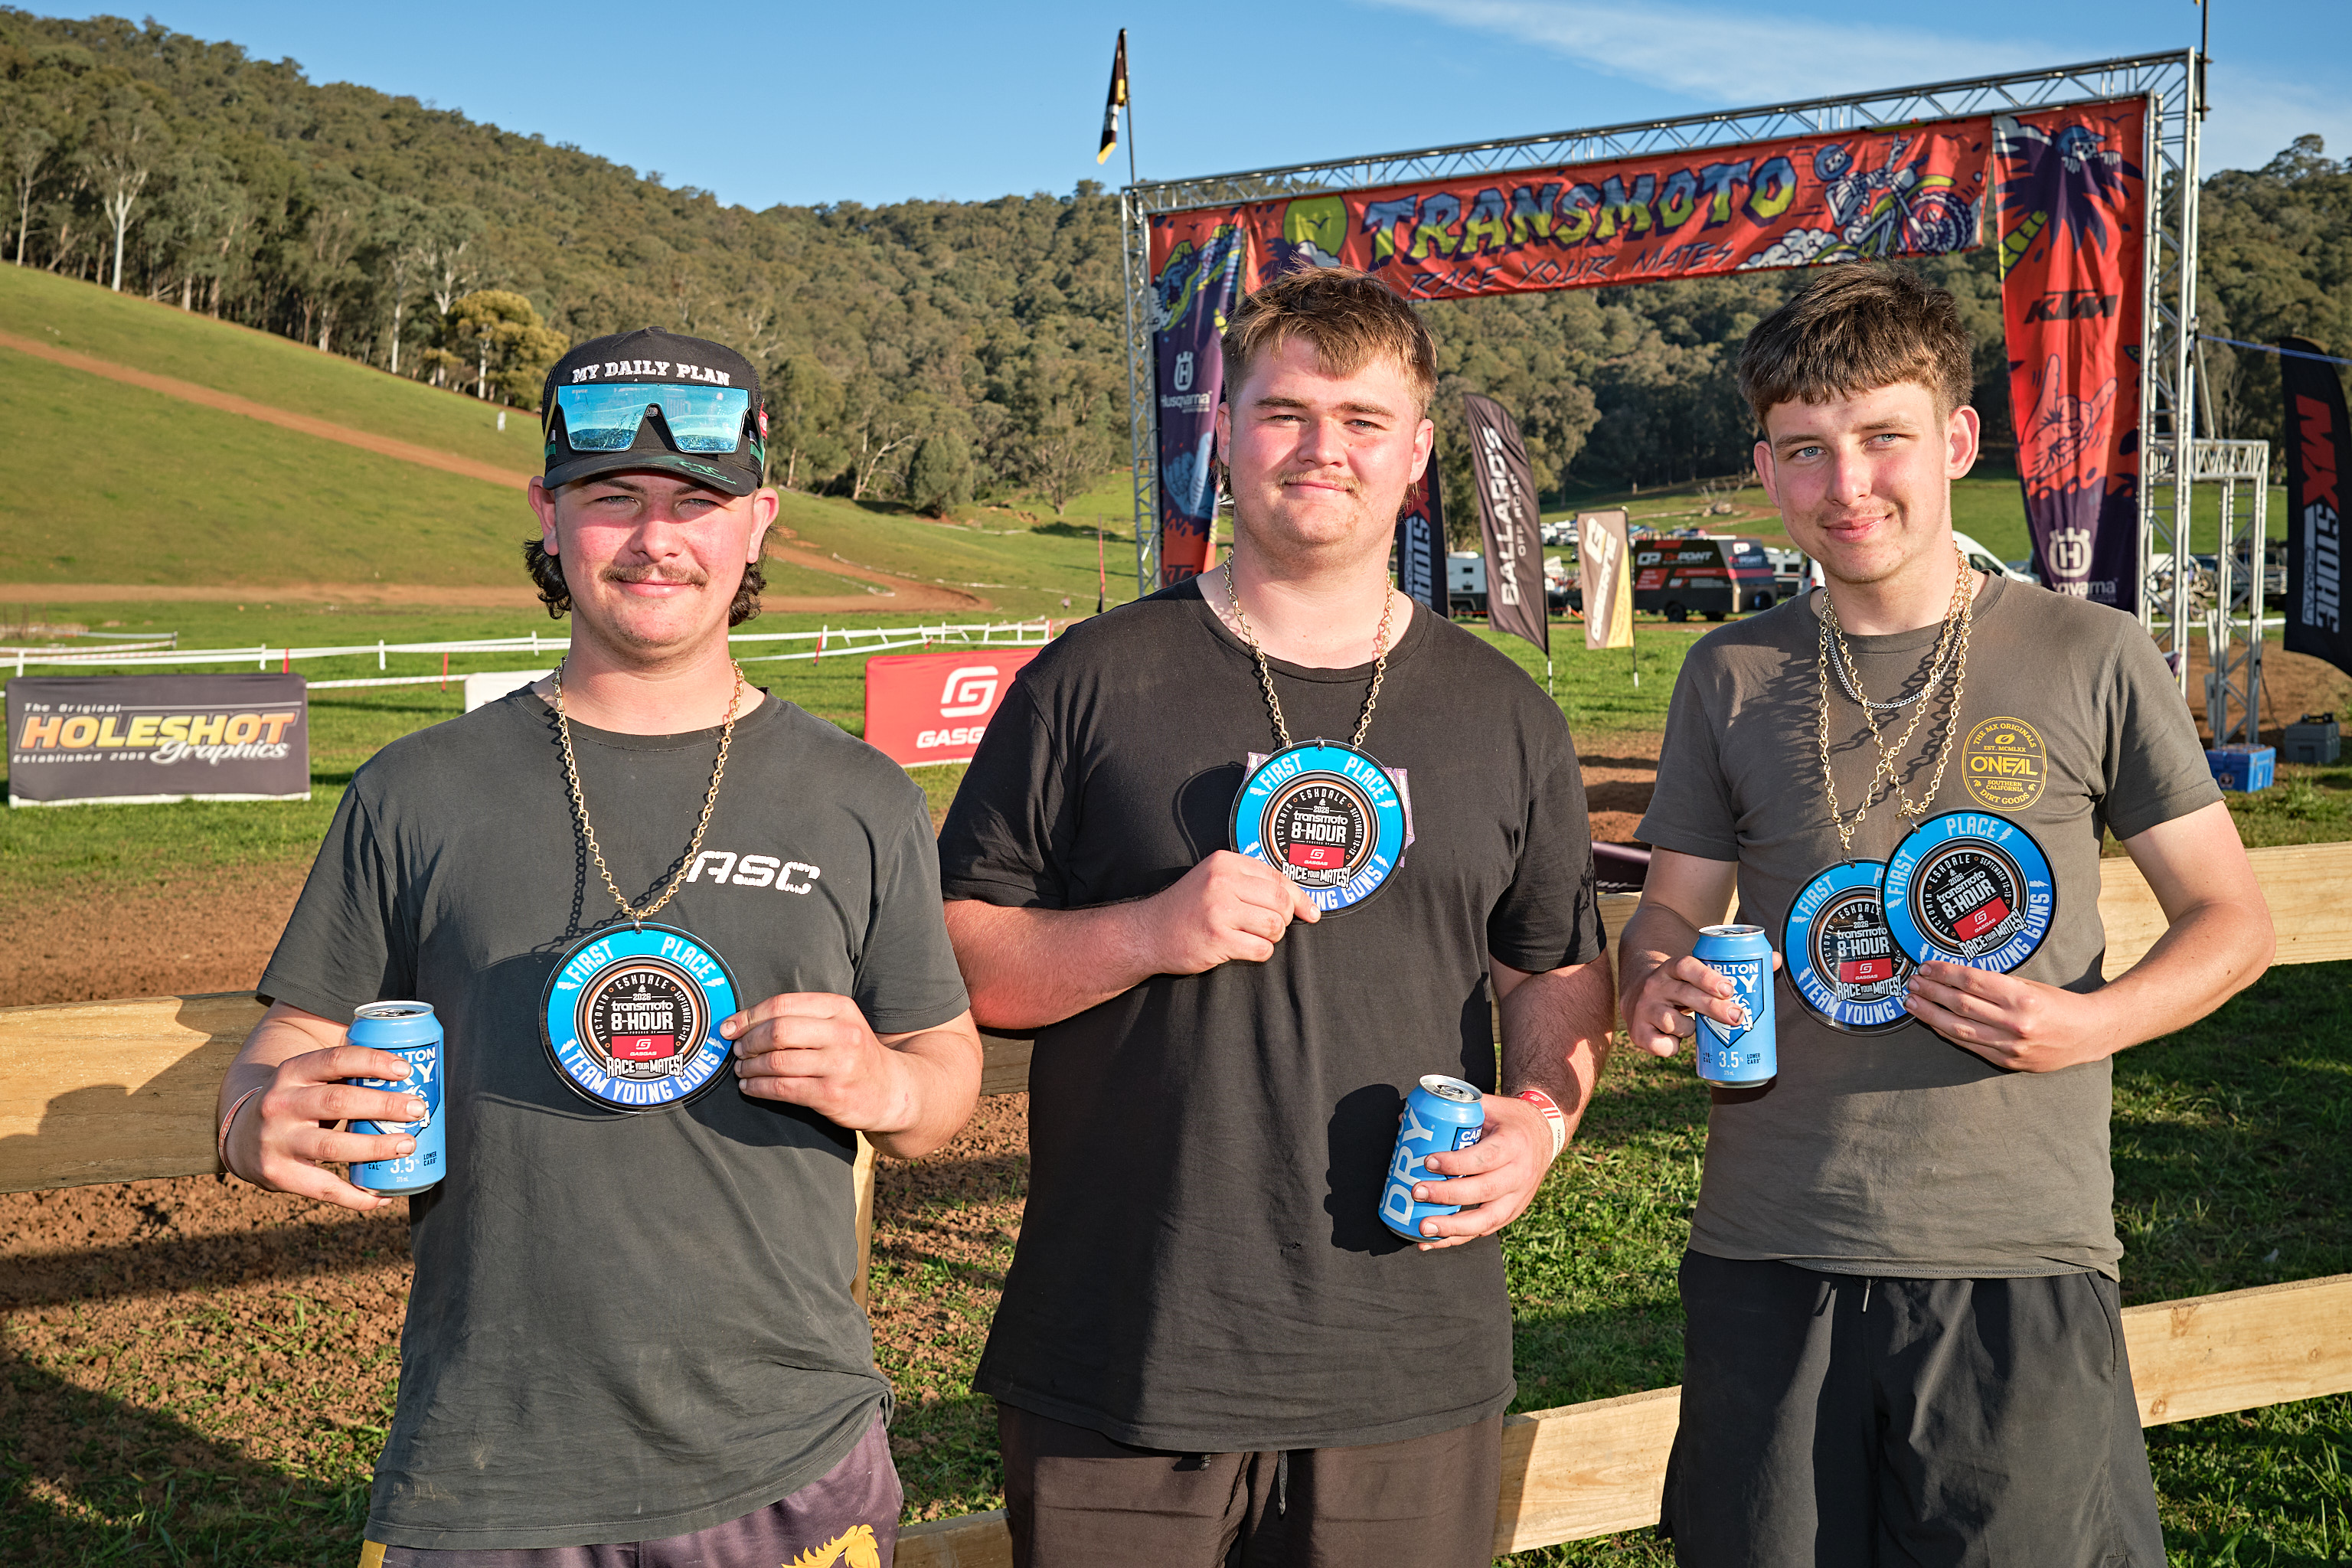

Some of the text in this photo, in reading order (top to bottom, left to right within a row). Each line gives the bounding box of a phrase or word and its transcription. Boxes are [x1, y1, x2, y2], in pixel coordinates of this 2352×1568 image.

[1363, 156, 1798, 264] TRANSMOTO
[1407, 240, 1735, 299] RACE YOUR MATES
[2024, 289, 2118, 324] KTM
[572, 359, 730, 387] MY DAILY PLAN
[2295, 394, 2340, 514] MX
[1482, 425, 1521, 606] BALLARD'S
[24, 702, 122, 715] The Original
[19, 712, 297, 750] HOLESHOT
[916, 726, 987, 749] GASG
[1973, 723, 2037, 749] THE MX ORIGINALS
[12, 752, 103, 765] Established
[1258, 753, 1392, 801] FIRST PLACE
[1986, 784, 2024, 792] CALIFORNIA
[1299, 788, 1348, 805] ESKDALE
[1313, 805, 1330, 814] 2026
[1979, 789, 2030, 805] DIRT GOODS
[1276, 802, 1293, 848] VICTORIA
[1291, 821, 1347, 844] 8-HOUR
[1293, 809, 1349, 825] transmoto
[1886, 848, 1916, 896] FIRST
[1945, 815, 2000, 838] PLACE
[1929, 854, 1971, 884] ESKDALE
[685, 850, 822, 895] ASC
[1282, 861, 1308, 882] RACE
[1319, 866, 1351, 889] MATES!
[1341, 864, 1383, 903] GUNS
[1936, 871, 1986, 903] transmoto
[1948, 872, 1965, 886] 2026
[1980, 857, 2012, 897] SEPTEMBER 12-13
[1798, 875, 1836, 916] FIRST
[1941, 878, 1998, 920] 8-HOUR
[1854, 920, 1869, 929] 2026
[1925, 893, 1949, 934] VICTORIA
[1975, 918, 1997, 933] GASGAS
[1823, 924, 1836, 968] VICTORIA
[1836, 926, 1888, 940] transmoto
[1837, 936, 1891, 958] 8-HOUR
[1957, 907, 2028, 962] RACE YOUR MATES!
[1978, 936, 2031, 973] YOUNG
[2023, 893, 2050, 940] GUNS
[565, 936, 717, 984] FIRST PLACE
[1802, 976, 1841, 1016] TEAM
[1844, 1000, 1897, 1024] YOUNG
[1836, 975, 1903, 1002] RACE YOUR MATES!
[594, 994, 609, 1041] VICTORIA
[611, 1000, 674, 1011] transmoto
[611, 1011, 674, 1031] 8-HOUR
[564, 1047, 722, 1104] TEAM YOUNG GUNS
[605, 1053, 684, 1079] RACE YOUR MATES!
[423, 1151, 437, 1160] LOWER
[1383, 1106, 1434, 1227] DRY
